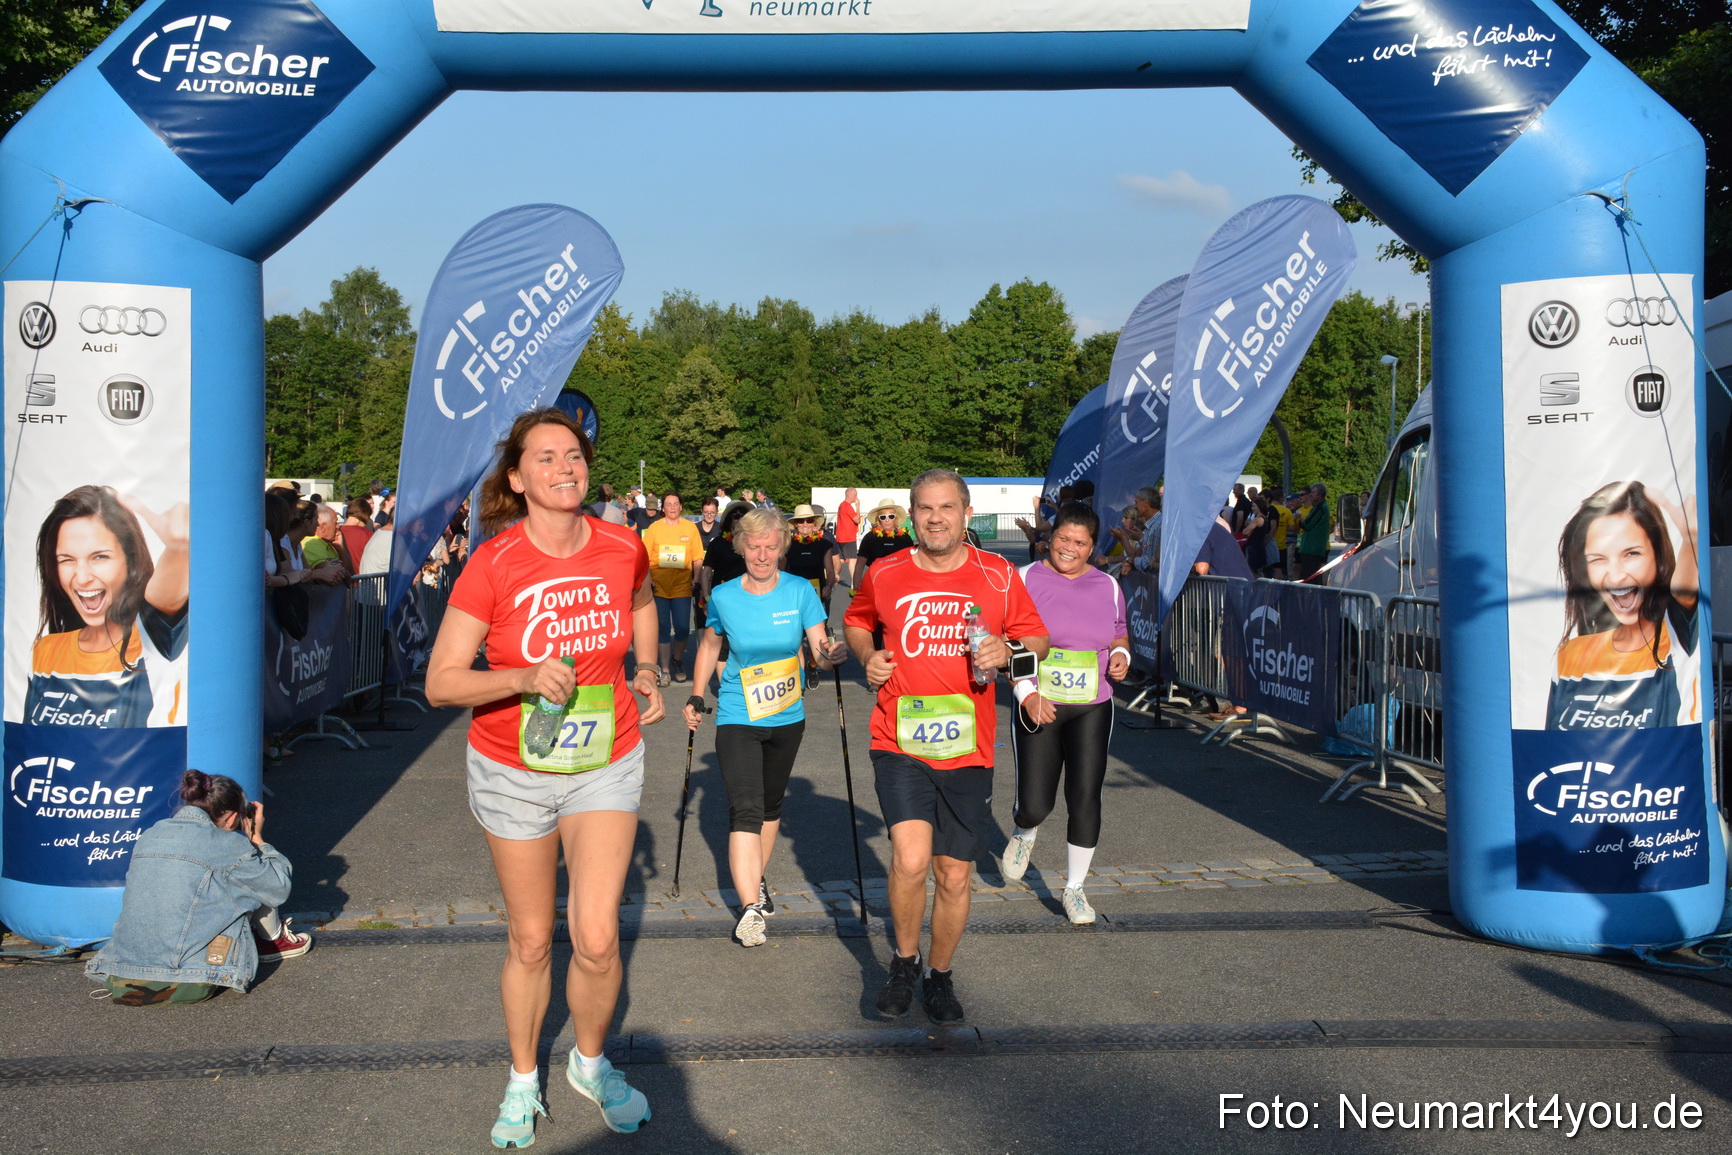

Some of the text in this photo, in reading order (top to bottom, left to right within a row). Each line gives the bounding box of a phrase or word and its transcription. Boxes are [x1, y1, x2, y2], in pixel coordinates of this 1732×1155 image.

[749, 0, 872, 16] neumarkt
[1373, 34, 1418, 60] und
[1425, 26, 1468, 49] das
[1472, 23, 1556, 47] Lächeln
[163, 43, 330, 79] Fischer
[1432, 49, 1552, 86] fährt mit!
[176, 79, 316, 97] AUTOMOBILE
[461, 242, 579, 394] Fischer
[1216, 230, 1316, 391] Fischer
[500, 273, 591, 394] AUTOMOBILE
[1253, 259, 1328, 388] AUTOMOBILE
[81, 342, 118, 353] Audi
[1608, 335, 1643, 347] Audi
[111, 388, 142, 411] FIAT
[1637, 380, 1662, 404] FIAT
[17, 413, 68, 424] SEAT
[1527, 412, 1595, 425] SEAT
[667, 554, 678, 562] 76
[514, 576, 611, 624] Town &
[895, 591, 973, 624] Town
[521, 609, 620, 664] Country
[559, 633, 608, 658] HAUS
[927, 643, 966, 657] HAUS
[1252, 636, 1315, 684] Fischer
[751, 676, 796, 704] 1089
[1051, 671, 1087, 689] 334
[1259, 680, 1312, 706] AUTOMOBILE
[913, 720, 961, 743] 426
[27, 778, 154, 805] Fischer
[1557, 783, 1686, 809] Fischer
[36, 807, 142, 819] AUTOMOBILE
[1570, 809, 1679, 824] AUTOMOBILE
[54, 833, 79, 847] und
[84, 830, 110, 844] das
[1595, 839, 1625, 853] und
[1628, 834, 1654, 848] das
[1656, 828, 1701, 847] Lächeln
[87, 849, 128, 866] fährt
[1633, 842, 1699, 870] fährt mit!
